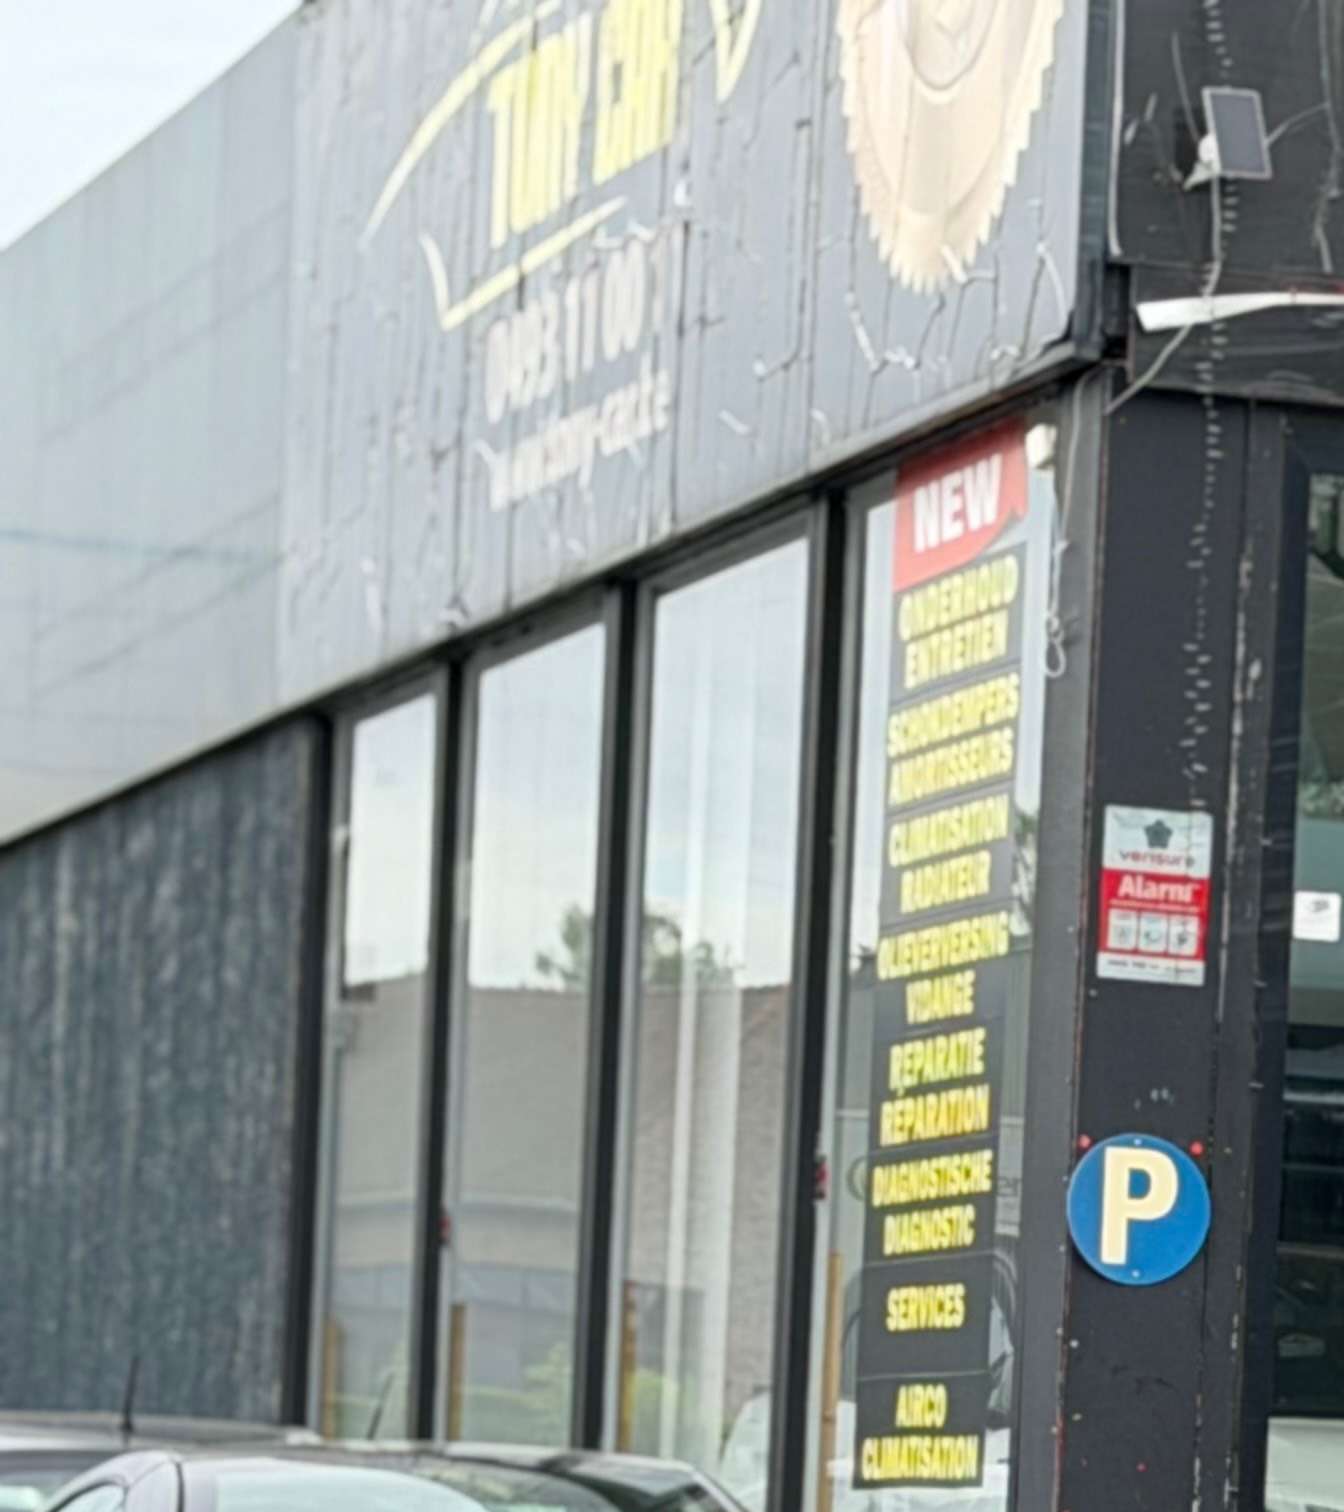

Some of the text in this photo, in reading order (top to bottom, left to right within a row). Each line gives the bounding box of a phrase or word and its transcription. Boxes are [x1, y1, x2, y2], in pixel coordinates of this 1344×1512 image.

[912, 457, 1000, 553] NEW
[899, 554, 1019, 641] ONDERHOUD
[905, 609, 1008, 689] ENTRETIEN
[888, 1027, 987, 1091] REPARATIE
[871, 1149, 993, 1207] DIAGNOSTISCHE
[1101, 1146, 1179, 1265] P
[882, 1205, 976, 1256] DIAGNOSTIC
[886, 1283, 967, 1332] SERVICES
[895, 1383, 949, 1429] AIRCO
[861, 1435, 981, 1481] CLIMATISATION
